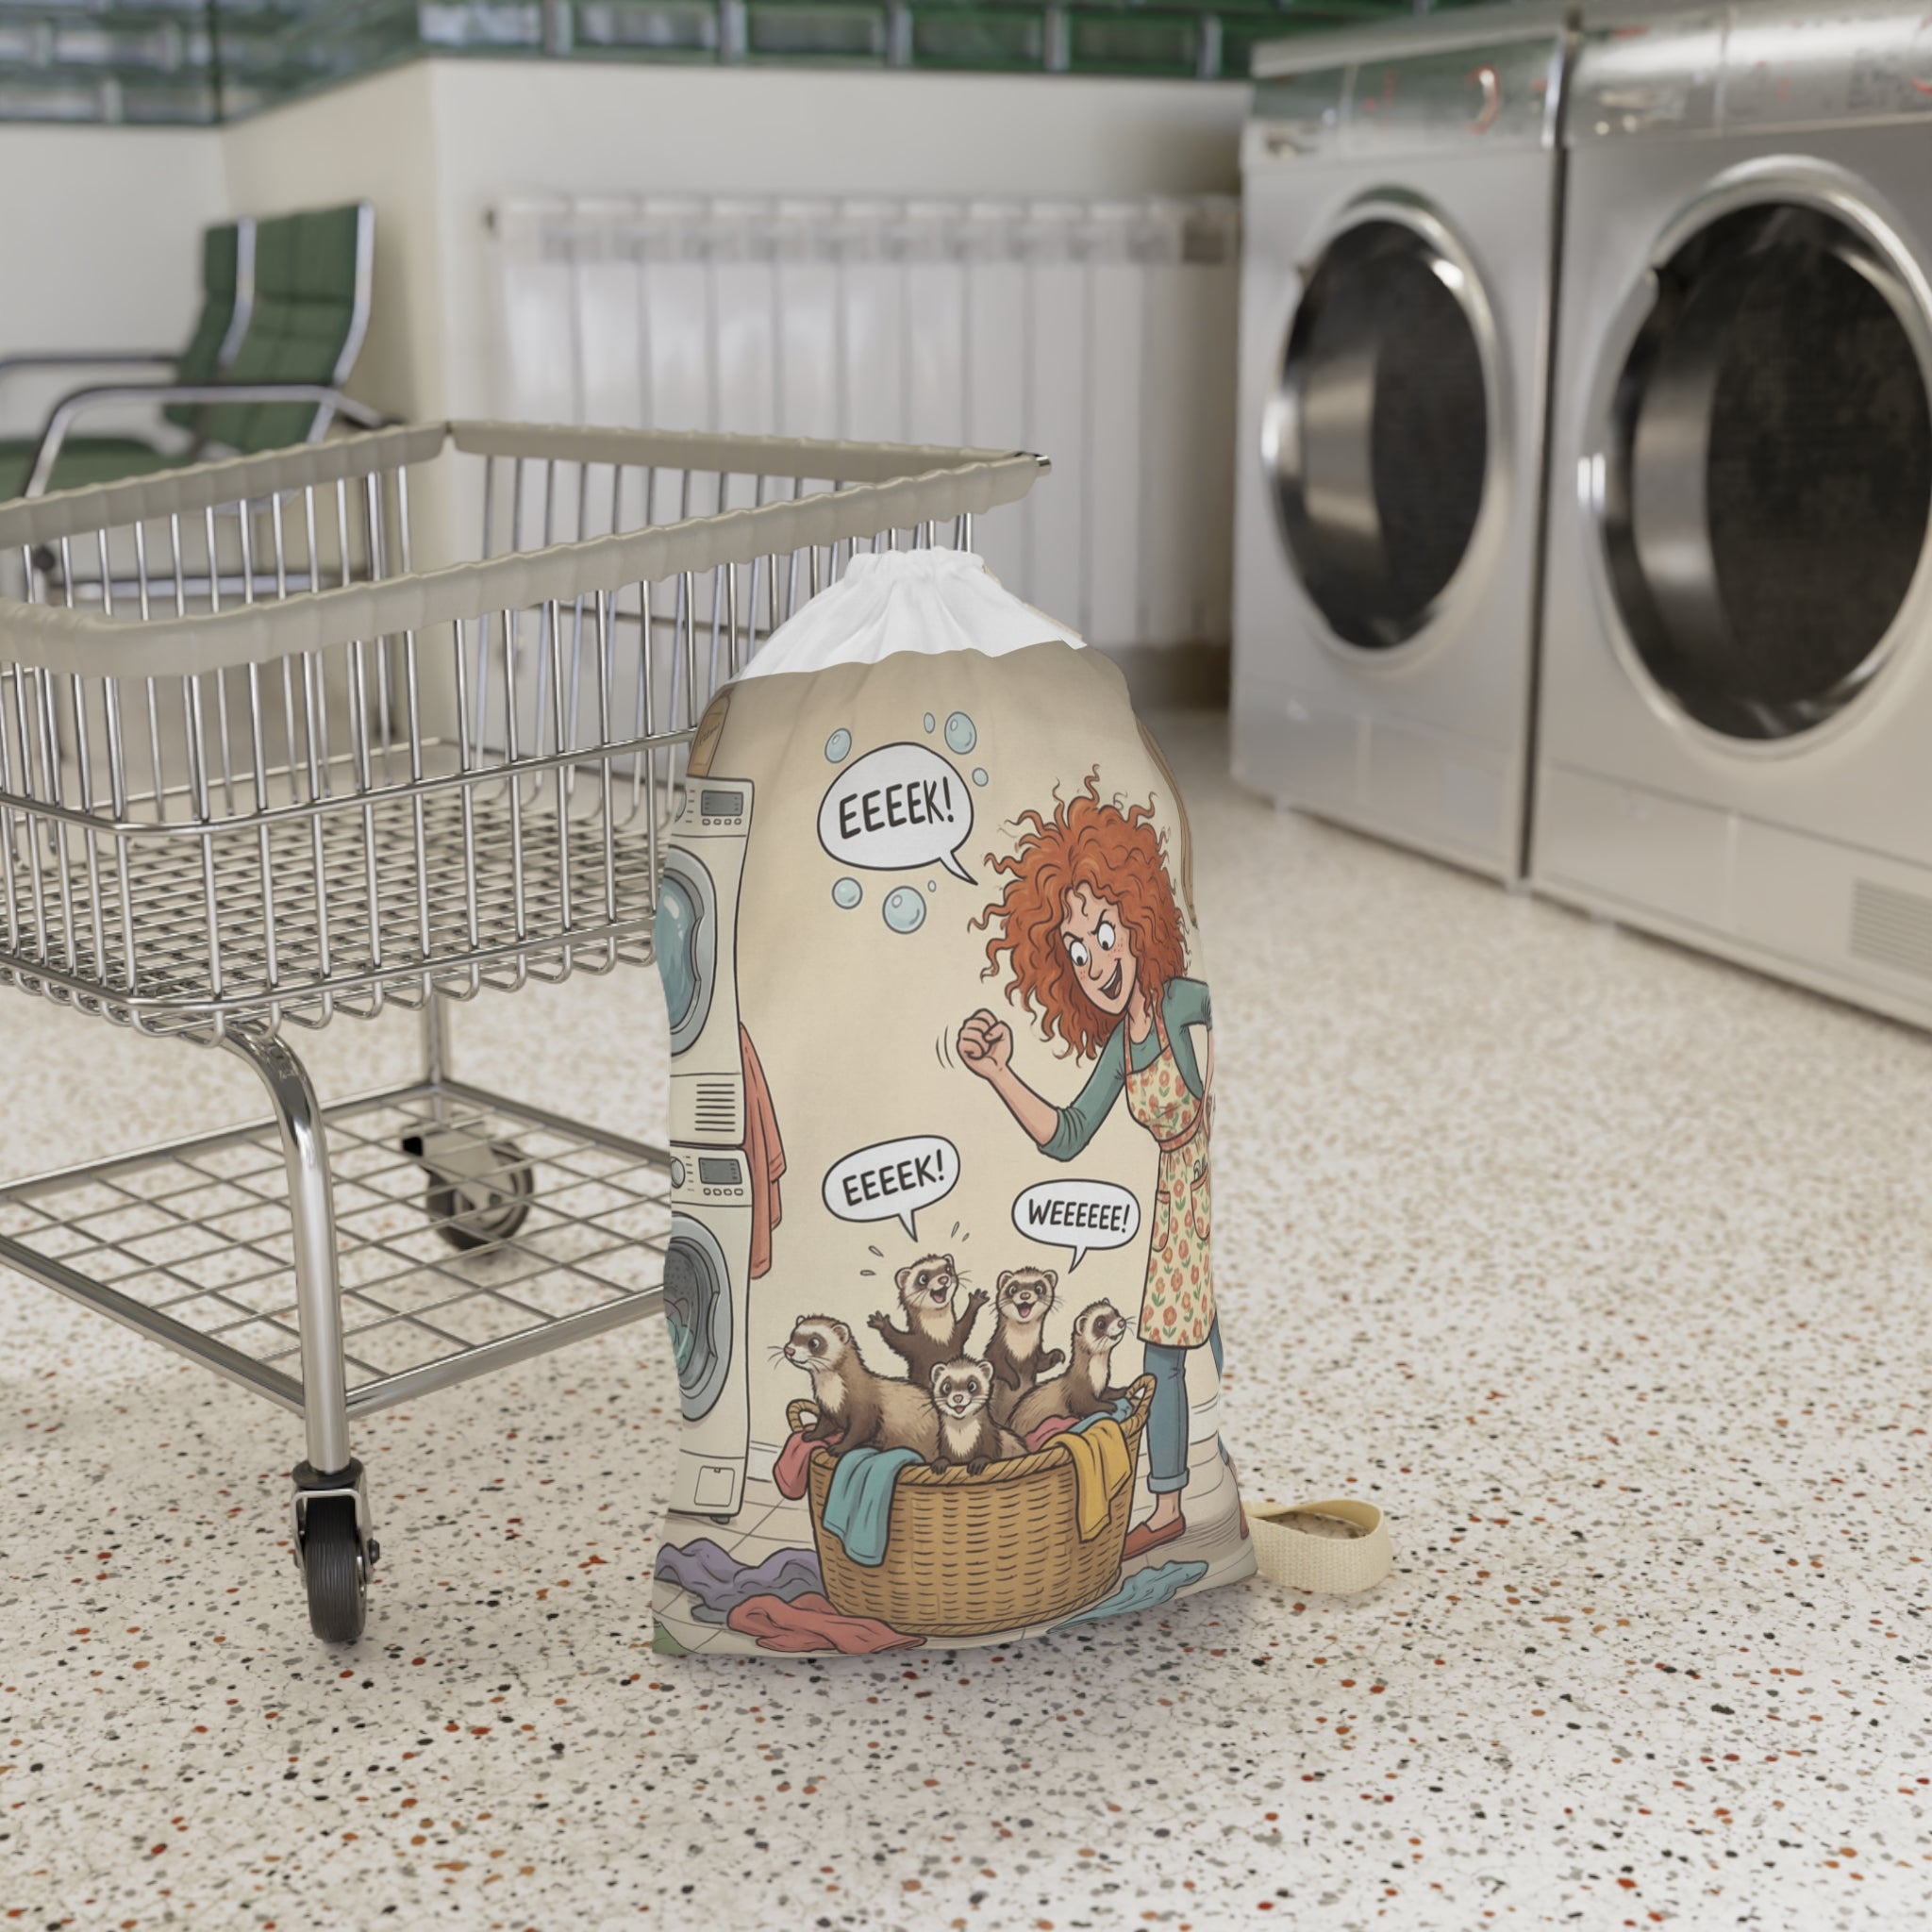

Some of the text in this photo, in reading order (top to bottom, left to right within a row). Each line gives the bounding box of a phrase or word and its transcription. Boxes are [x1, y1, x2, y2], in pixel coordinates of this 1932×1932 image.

[839, 775, 955, 840] EEEEK!
[841, 1148, 944, 1207] EEEEK!
[1028, 1198, 1130, 1234] WEEEEEE!
